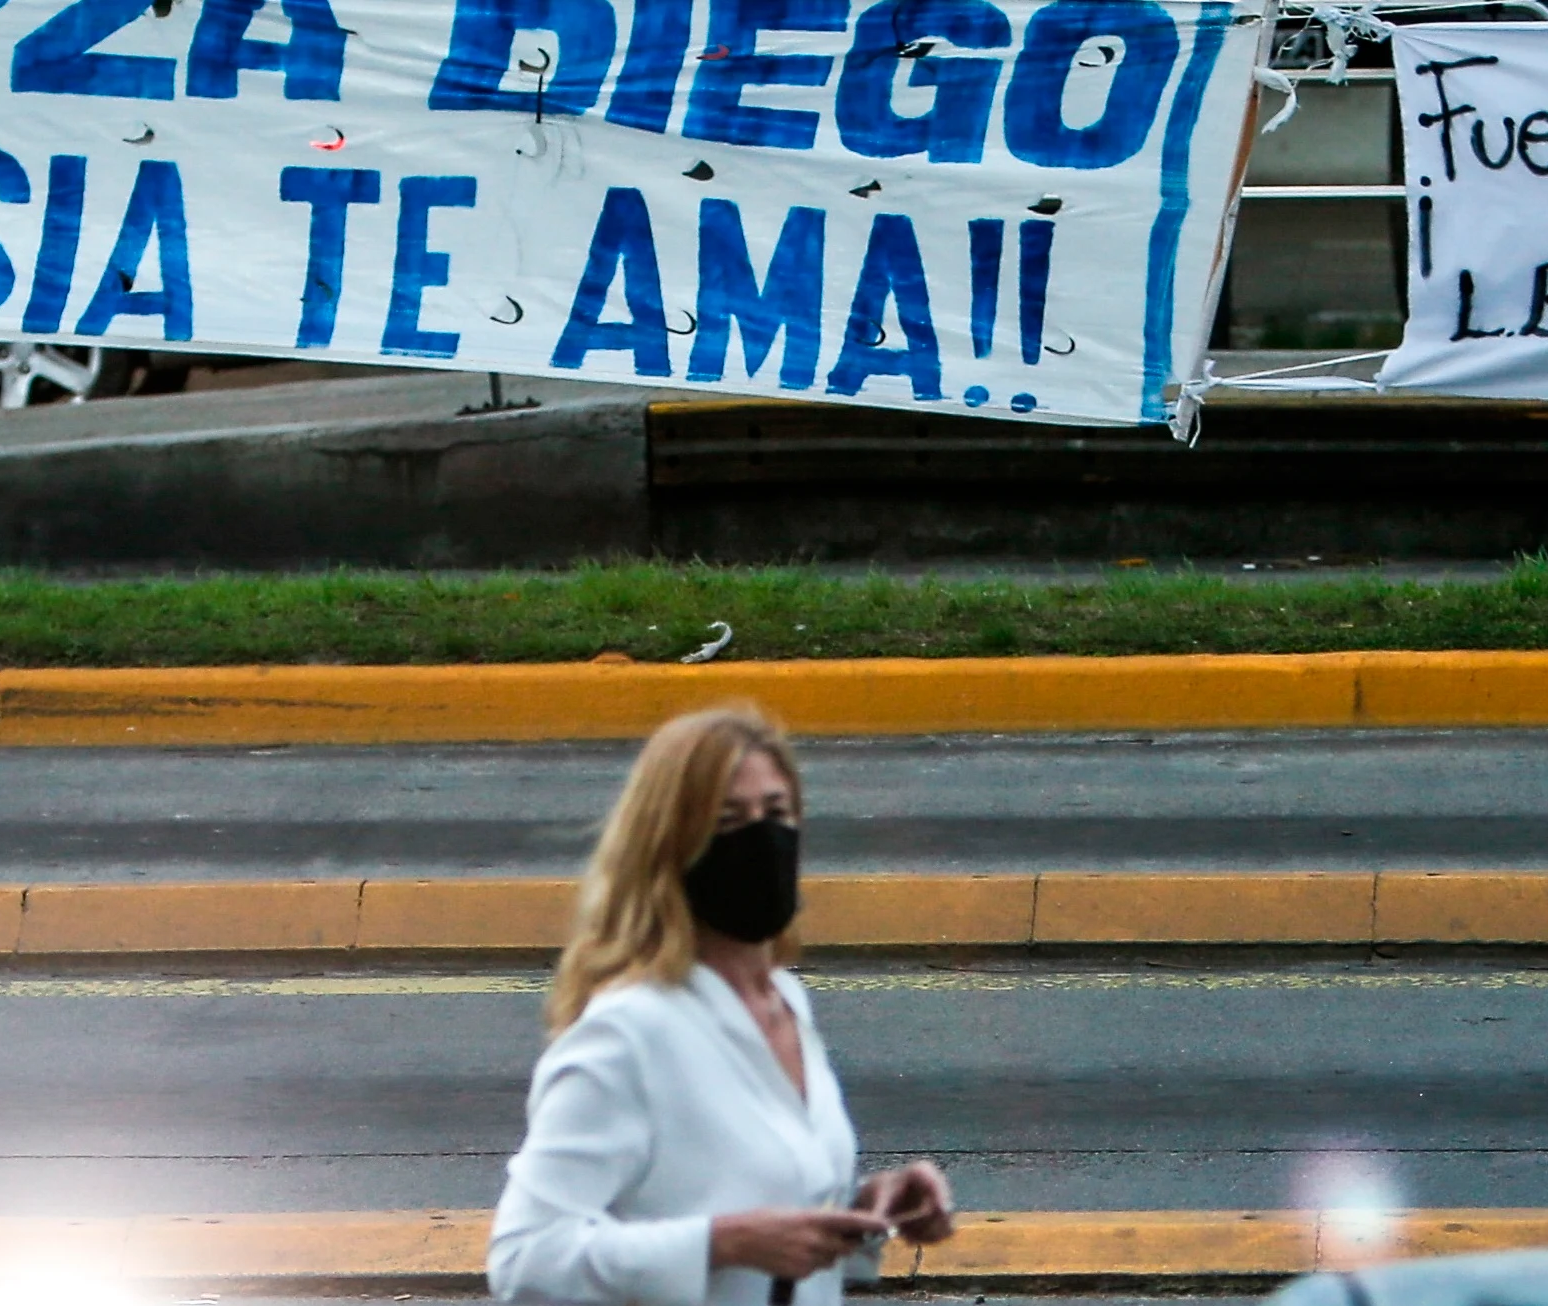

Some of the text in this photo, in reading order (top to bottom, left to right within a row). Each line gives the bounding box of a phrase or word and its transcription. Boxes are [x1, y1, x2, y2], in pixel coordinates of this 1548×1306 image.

[428, 0, 1180, 169] DIEGO
[280, 166, 477, 358] TE
[552, 187, 1058, 414] AMA!!
